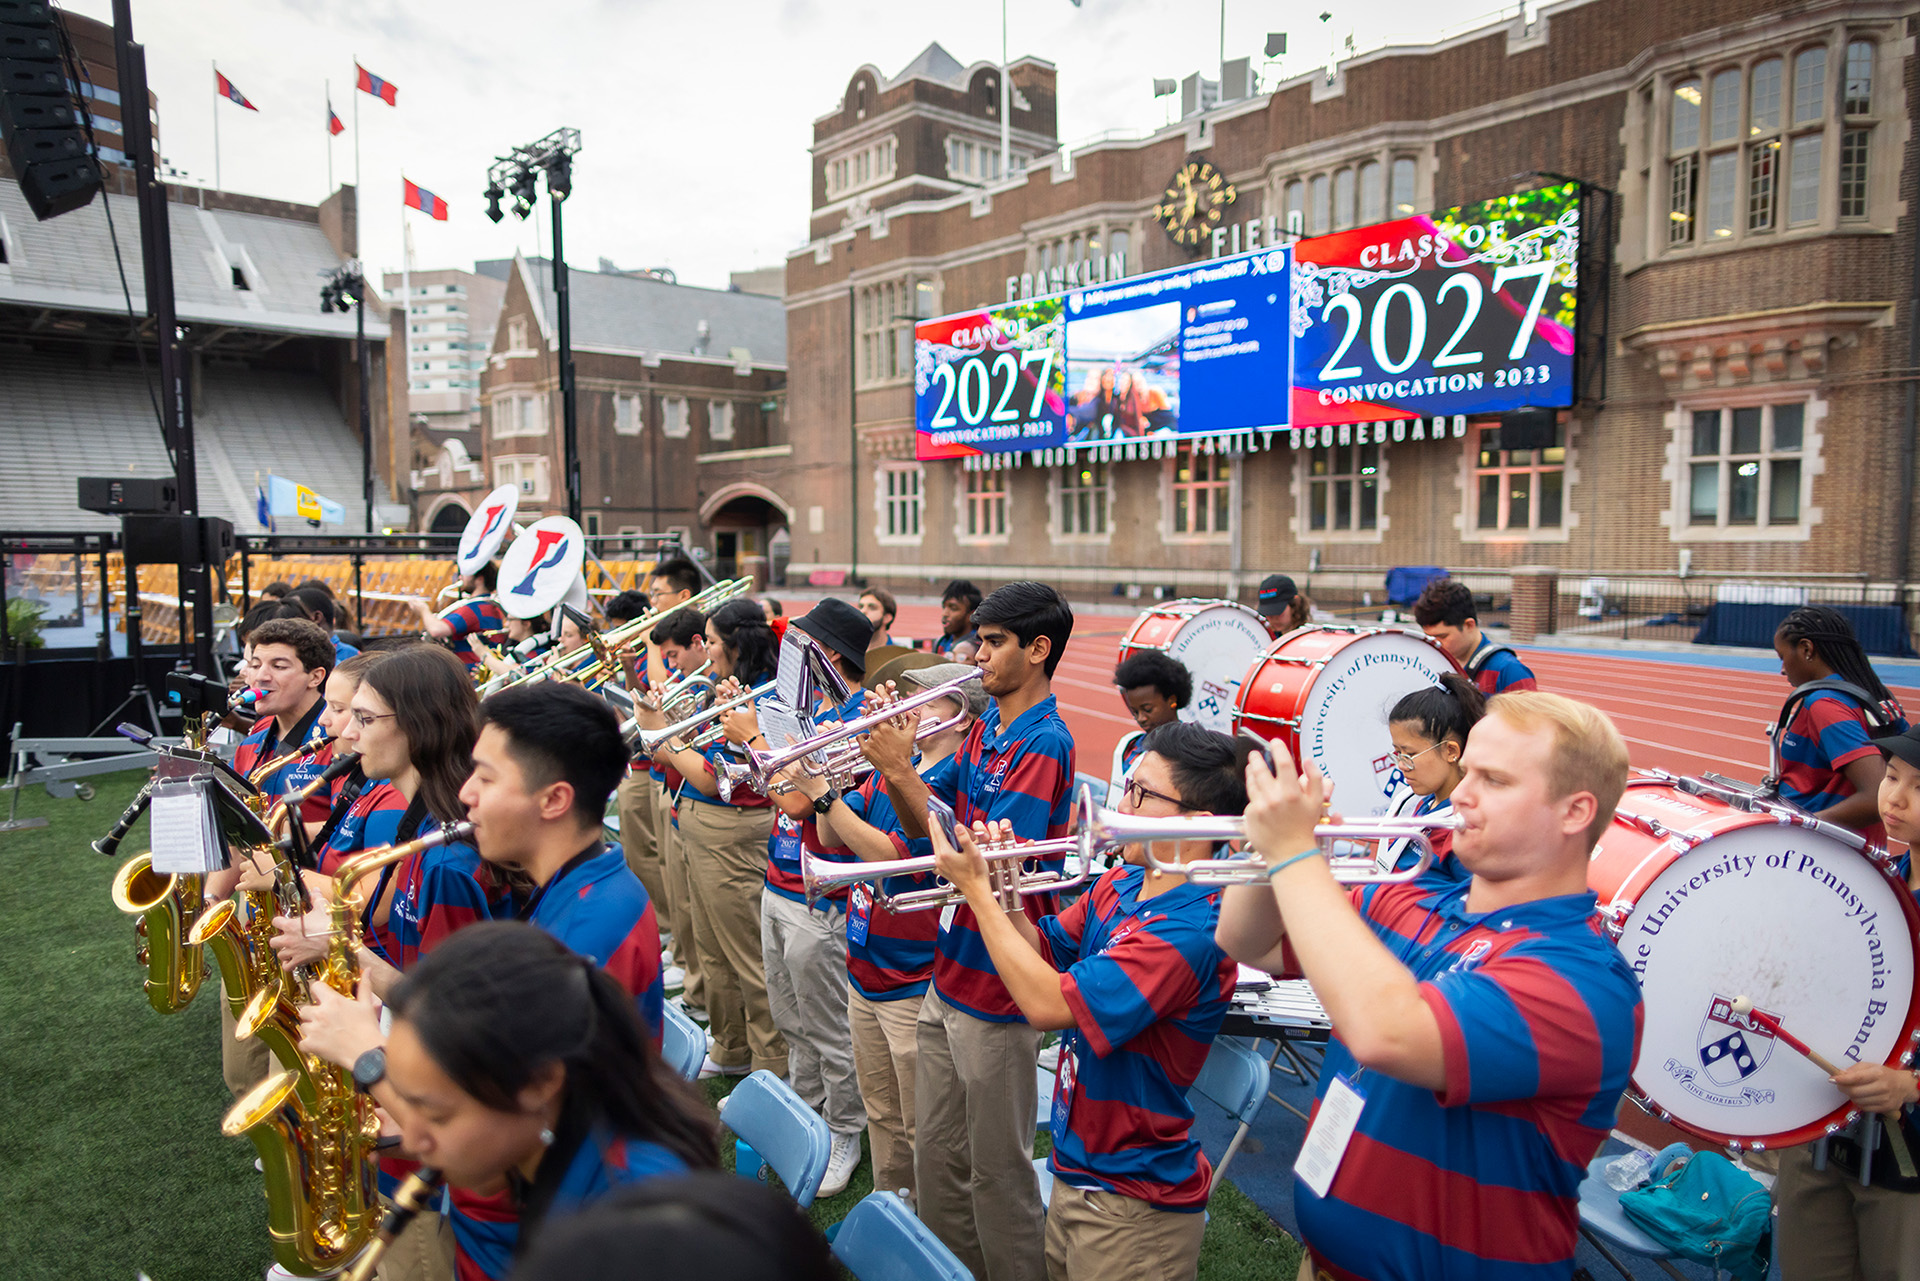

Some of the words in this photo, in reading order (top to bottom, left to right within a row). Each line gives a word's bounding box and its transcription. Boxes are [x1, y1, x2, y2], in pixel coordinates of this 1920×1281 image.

[1006, 251, 1126, 301] FRANKLIN
[1212, 209, 1304, 258] FIELD
[1360, 234, 1450, 268] CLASS
[1463, 220, 1505, 248] OF
[951, 324, 1000, 348] CLASS
[1005, 318, 1028, 339] OF
[1317, 259, 1556, 382] 2027
[930, 347, 1055, 429] 2027
[1318, 371, 1484, 406] CONVOCATION
[1494, 364, 1551, 389] 2023
[930, 423, 1019, 446] CONVOCATION
[1022, 420, 1054, 438] 2023
[963, 450, 1022, 472] ROBERT
[1031, 447, 1077, 468] WOOD
[1088, 440, 1177, 464] JOHNSON
[1191, 431, 1273, 456] FAMILY
[1289, 414, 1467, 450] SCOREBOARD
[510, 529, 569, 596] P
[1178, 618, 1222, 653] University
[1225, 618, 1235, 628] of
[1236, 621, 1262, 651] Pennsy
[1313, 675, 1345, 758] University
[1347, 657, 1362, 676] of
[1364, 653, 1440, 684] Pennsylvan
[1765, 850, 1795, 869] of
[1640, 853, 1756, 936] University
[1797, 853, 1892, 991] Pennsylvania
[1843, 999, 1888, 1063] Band
[1686, 1083, 1703, 1096] SINE
[1706, 1094, 1743, 1105] MORIBUS
